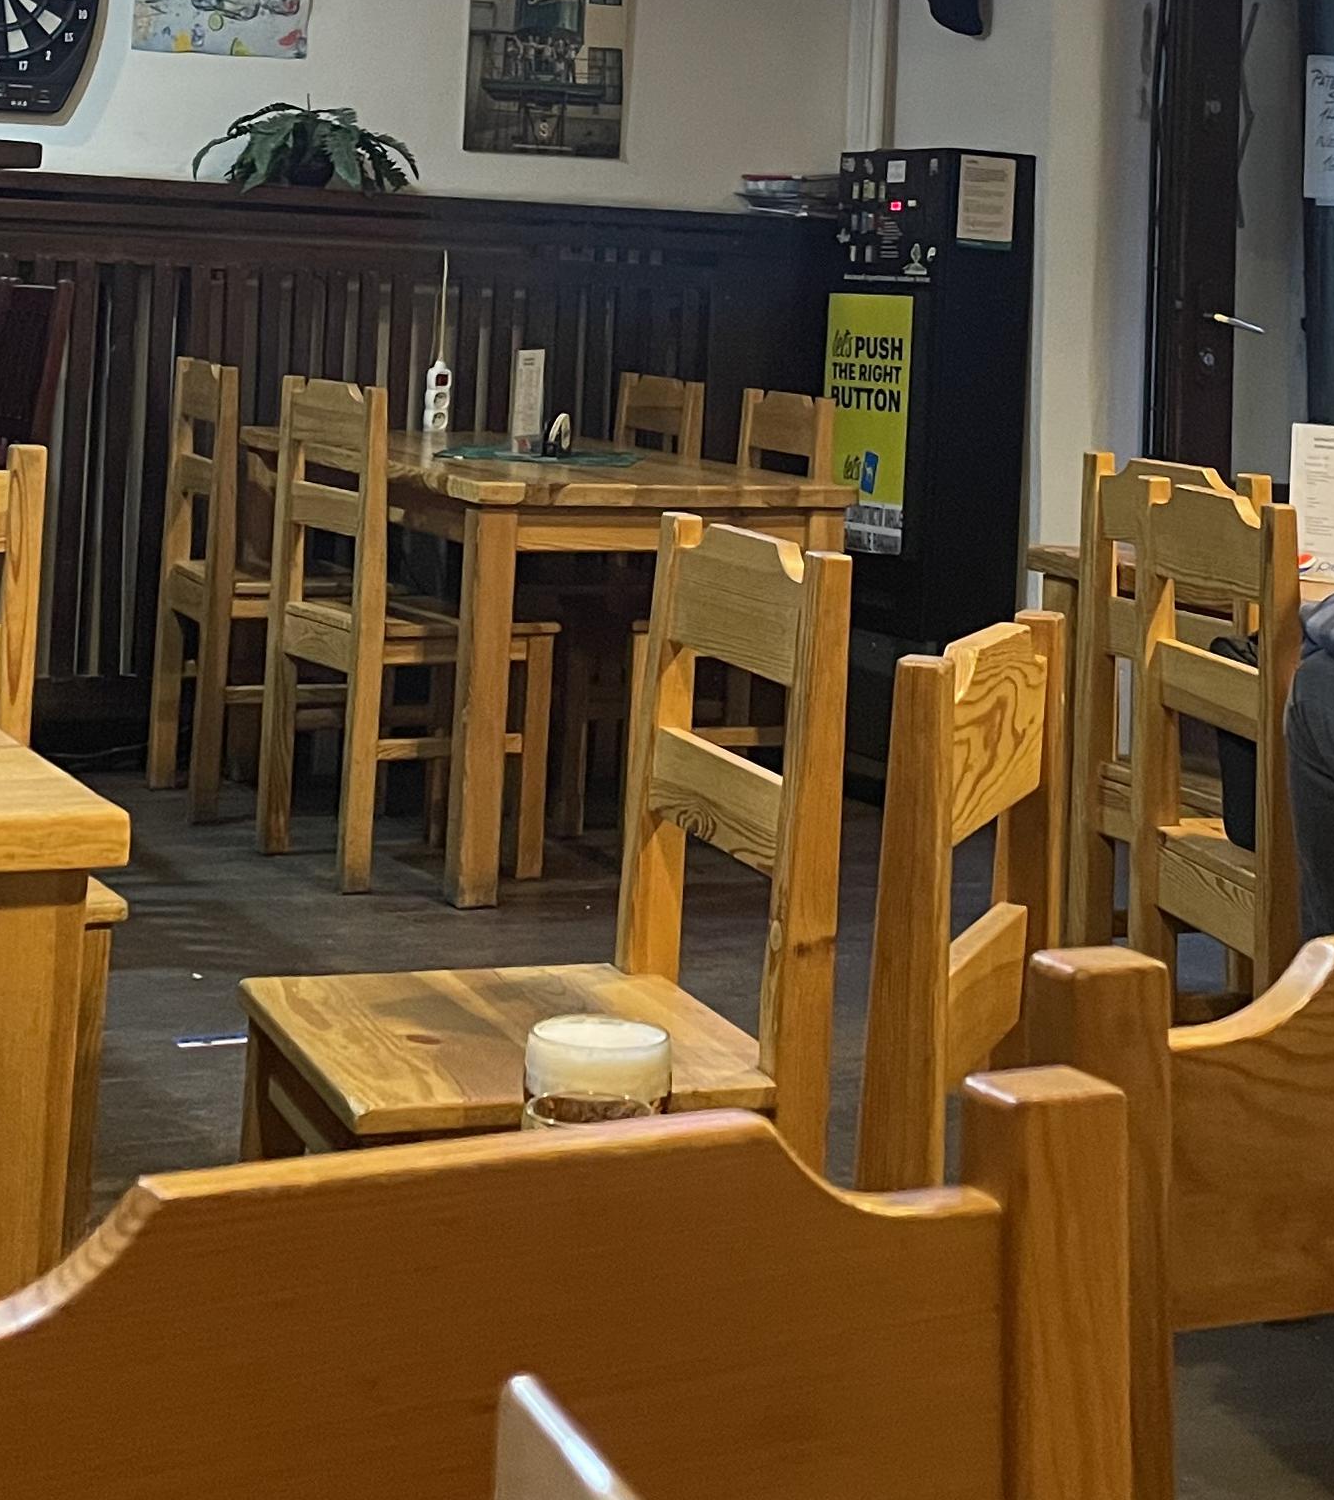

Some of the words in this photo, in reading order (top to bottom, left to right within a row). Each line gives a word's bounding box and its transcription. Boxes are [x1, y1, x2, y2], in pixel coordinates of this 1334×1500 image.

[855, 336, 903, 361] PUSH
[832, 362, 855, 381] THE
[858, 364, 902, 384] RIGHT
[831, 385, 901, 412] BUTTON
